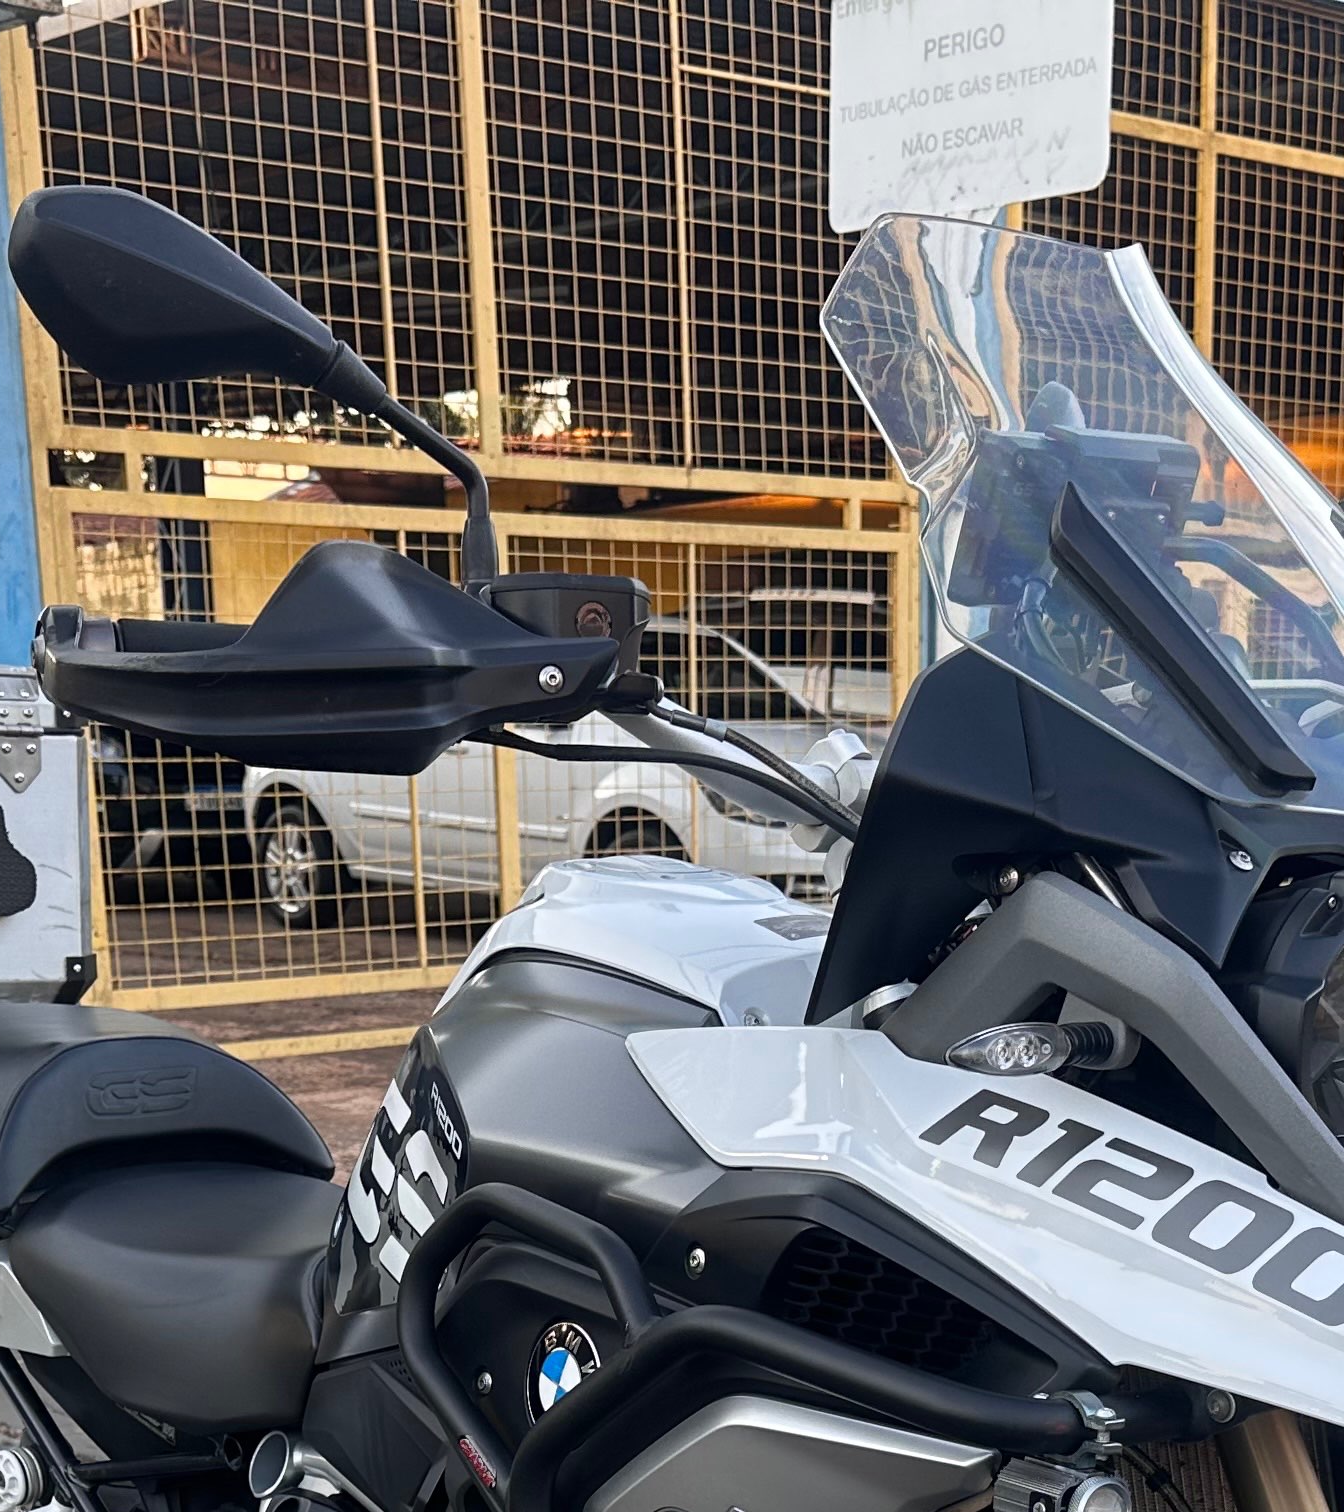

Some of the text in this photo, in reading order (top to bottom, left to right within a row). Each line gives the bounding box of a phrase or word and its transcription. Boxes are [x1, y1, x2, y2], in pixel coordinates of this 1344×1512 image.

[923, 23, 1005, 61] PERIGO
[839, 88, 929, 124] TUBULAÇÃO
[933, 83, 955, 104] DE
[996, 56, 1097, 91] ENTERRADA
[901, 117, 1024, 159] NÃO ESCAVAR
[430, 1081, 462, 1161] R1200
